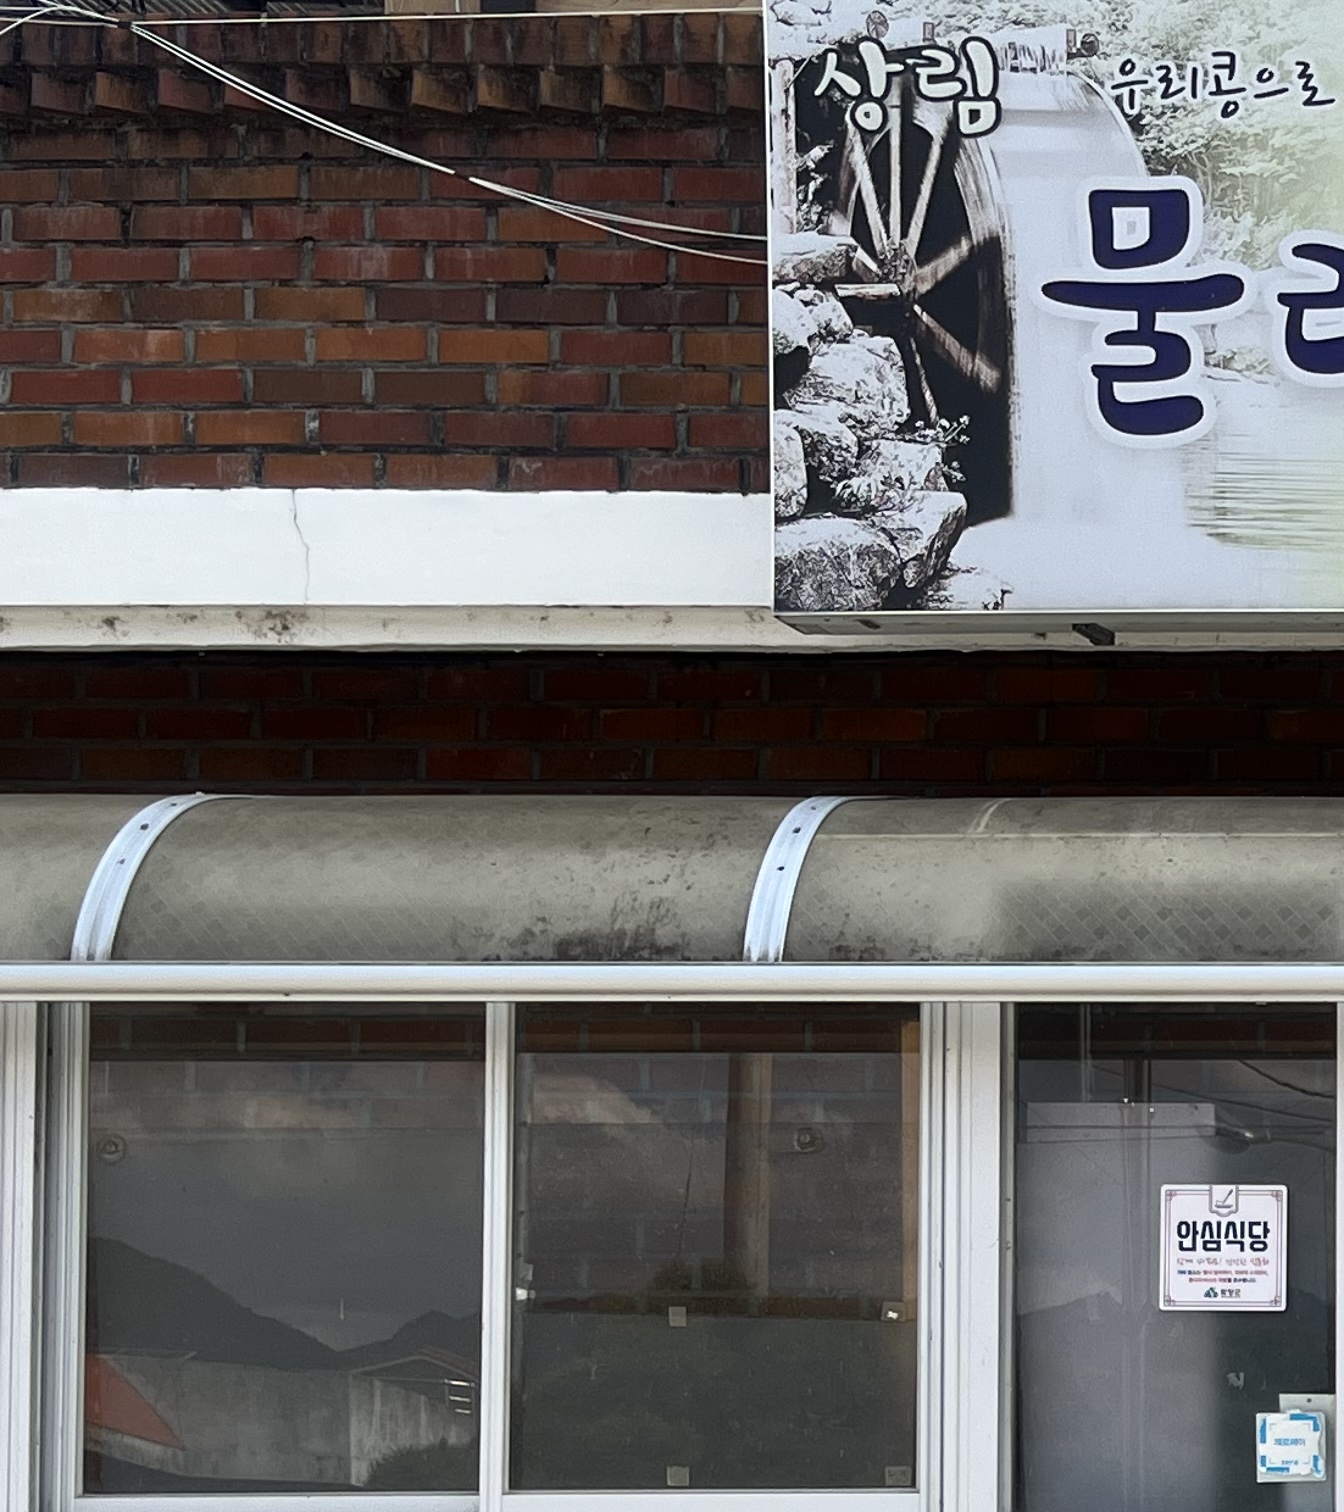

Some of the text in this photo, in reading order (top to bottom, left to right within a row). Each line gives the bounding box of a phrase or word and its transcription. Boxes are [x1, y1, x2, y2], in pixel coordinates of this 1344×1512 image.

[812, 38, 1001, 137] 상림
[1110, 53, 1336, 117] 우리콩으로
[1176, 1220, 1271, 1253] 안심식당
